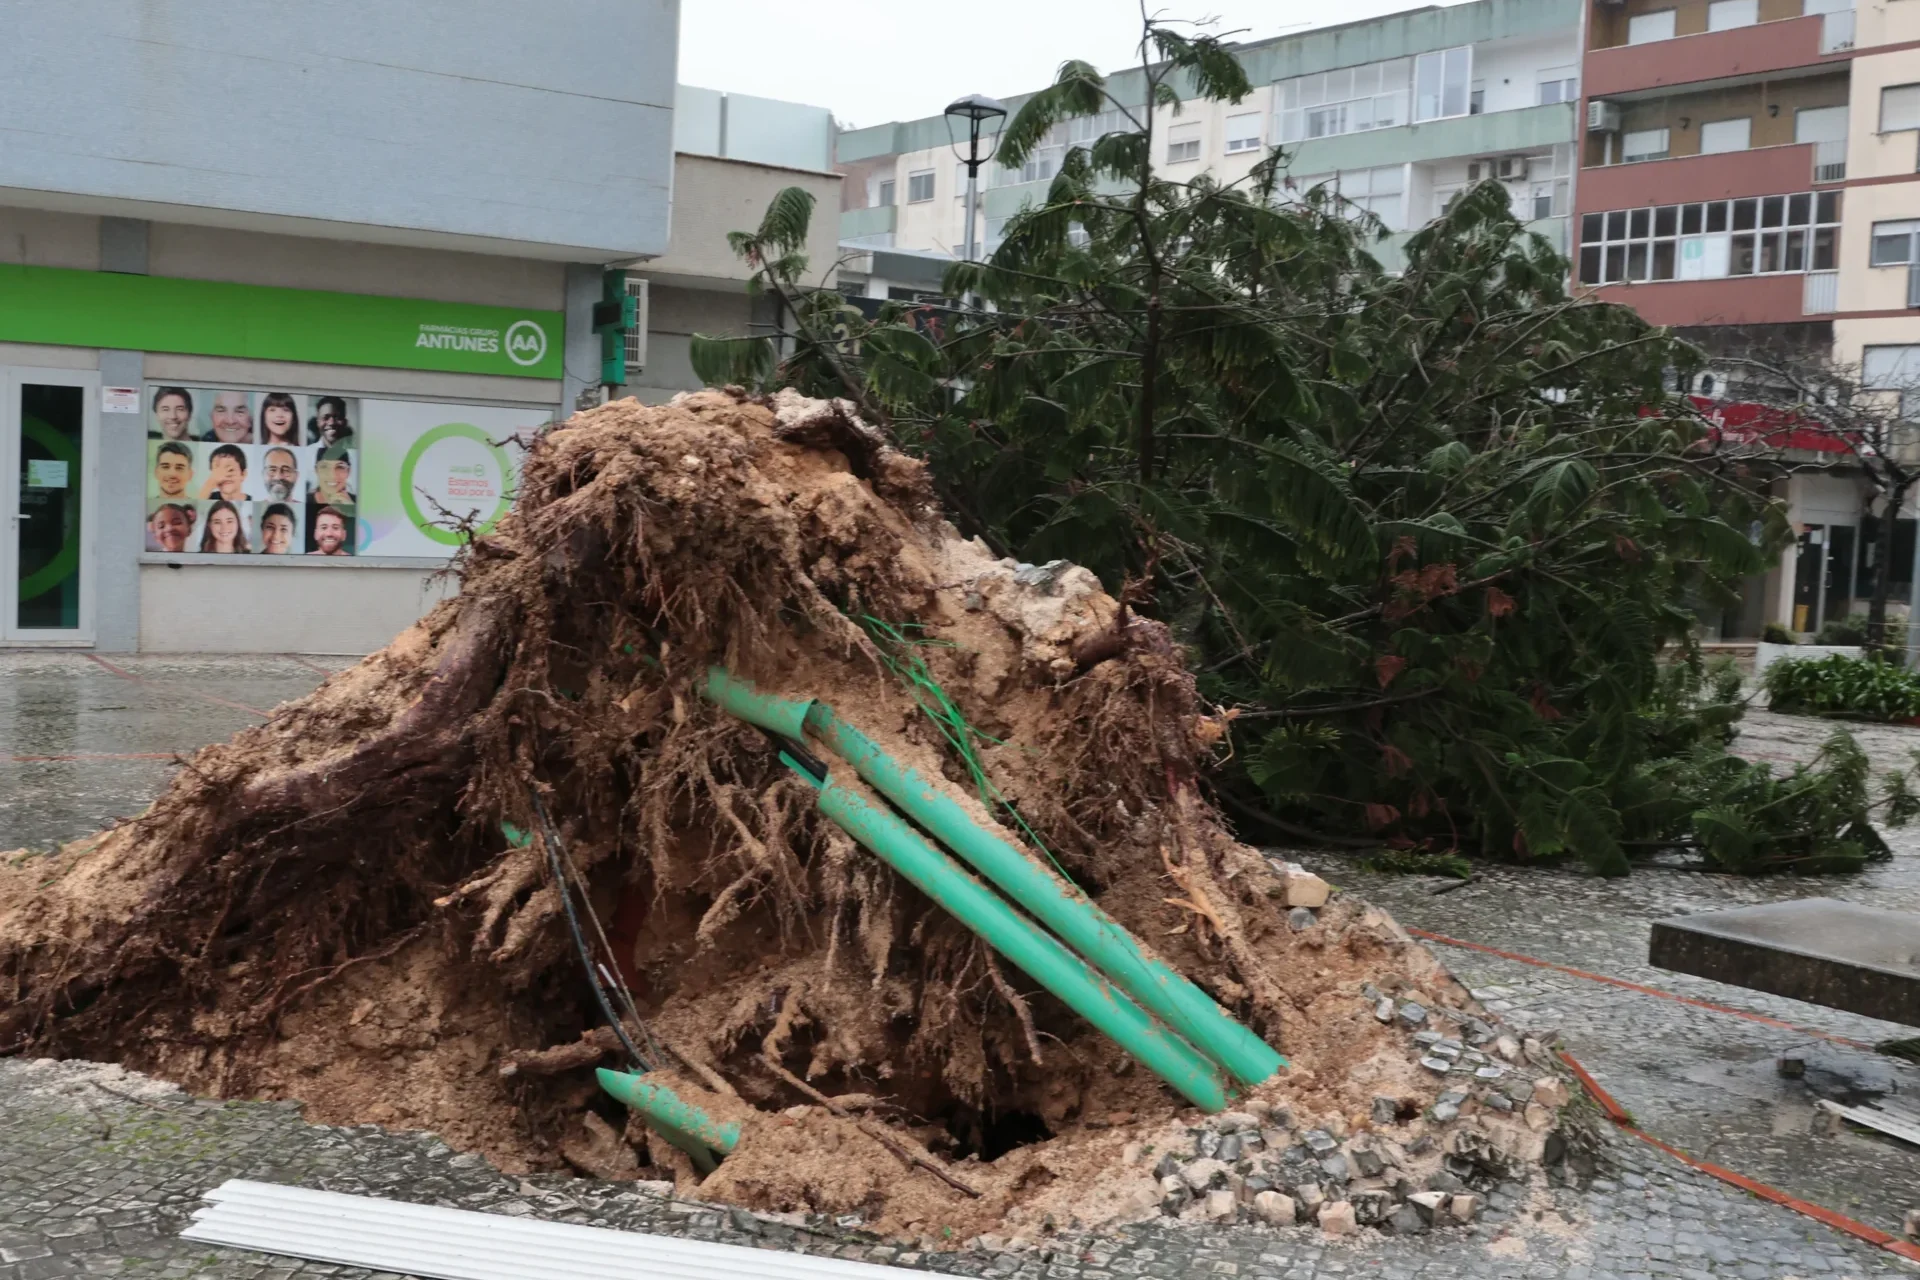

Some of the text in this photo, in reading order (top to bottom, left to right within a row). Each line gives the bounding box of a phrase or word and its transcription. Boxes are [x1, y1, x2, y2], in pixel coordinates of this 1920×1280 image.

[415, 333, 499, 353] ANTUNES
[512, 334, 539, 351] AA
[448, 477, 488, 487] Estamos
